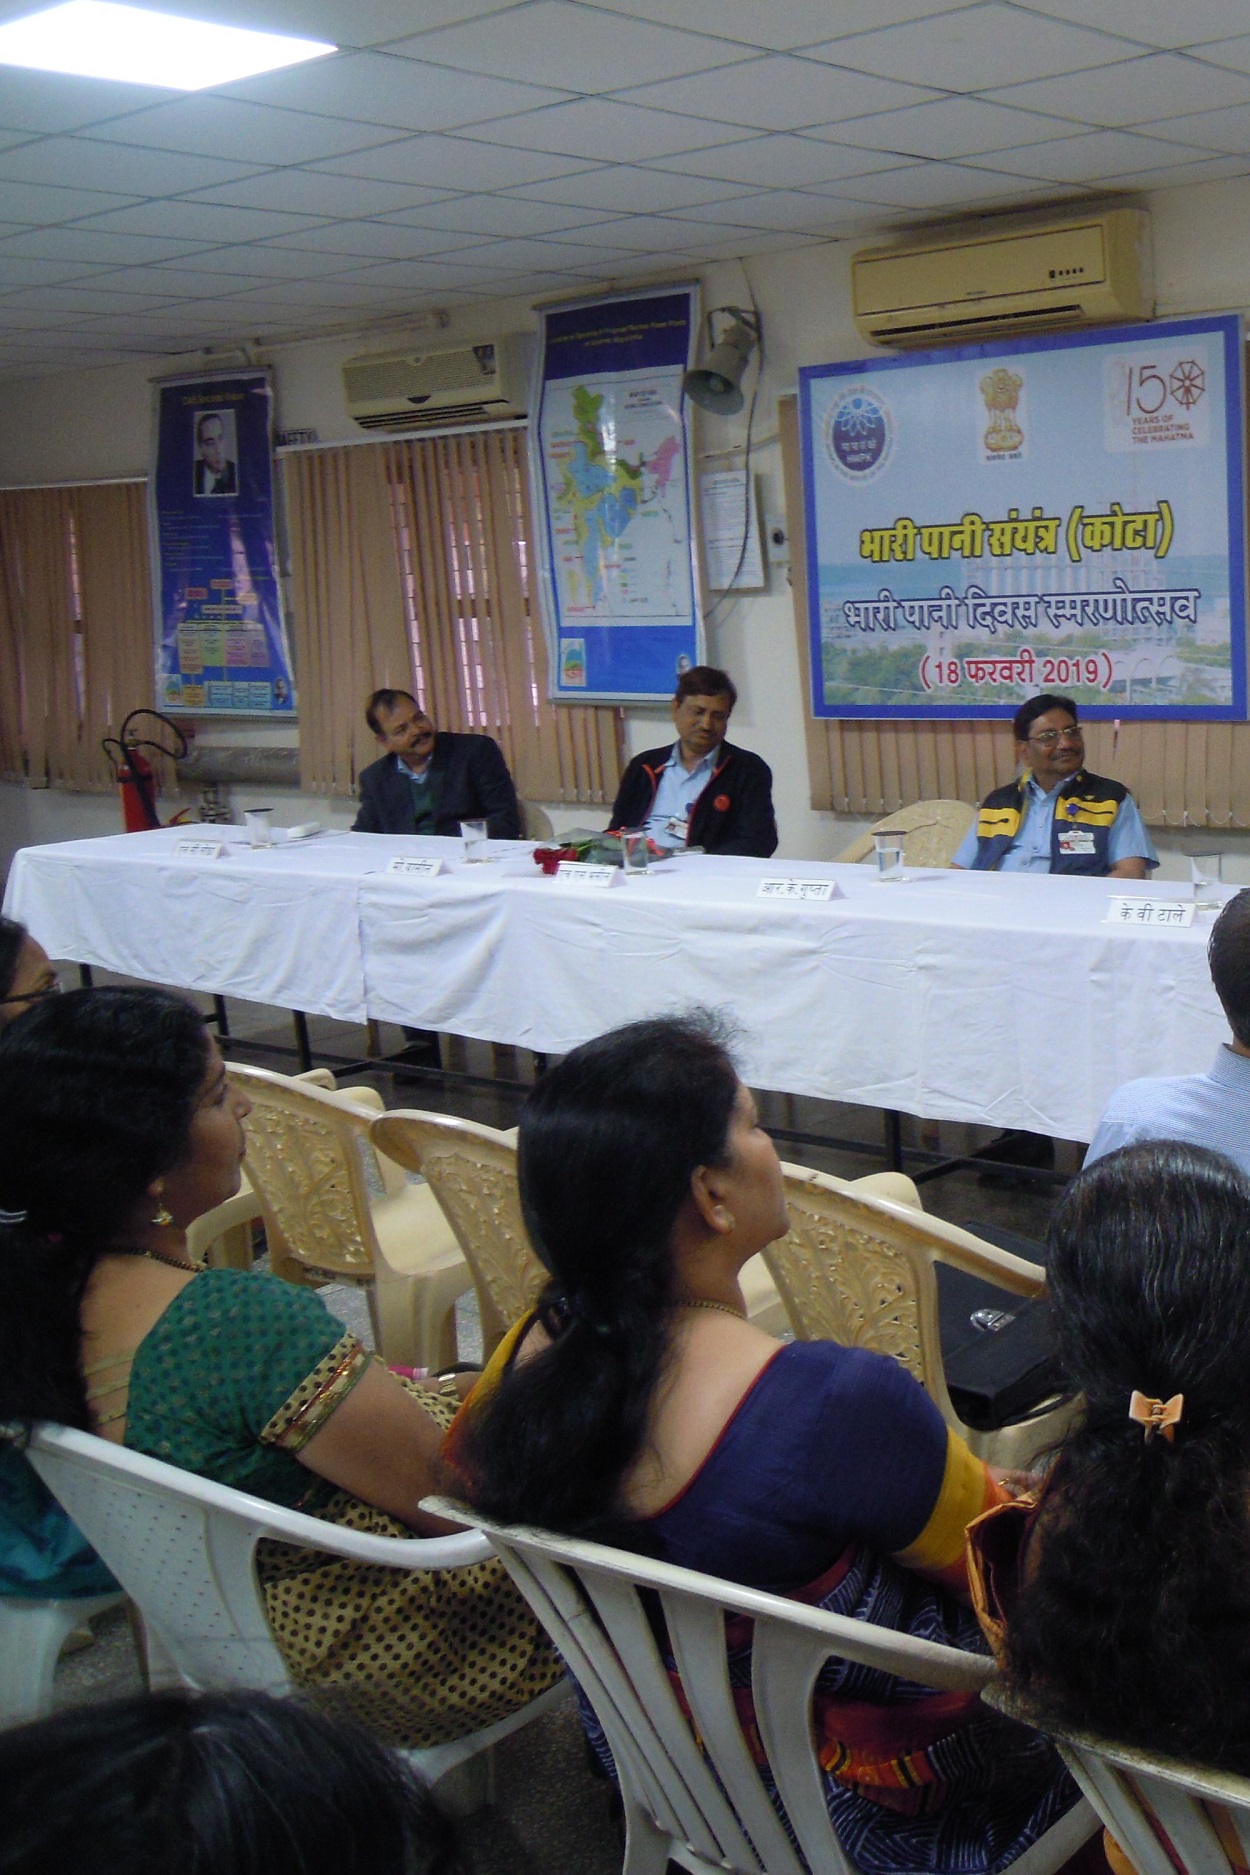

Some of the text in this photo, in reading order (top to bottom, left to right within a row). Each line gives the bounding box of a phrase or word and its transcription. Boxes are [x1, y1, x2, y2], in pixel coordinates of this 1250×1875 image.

[1132, 414, 1174, 426] YEARS OF
[1132, 423, 1190, 435] CELEBRATING
[1132, 432, 1194, 445] THE MAHATMA
[860, 500, 1174, 562] भारी पानी संयंत्र (कोटा)
[843, 577, 1201, 634] भारी पानी दिवस स्मरणोत्सव
[964, 648, 1035, 684] फरवरी
[1120, 902, 1187, 922] के वी टाले
